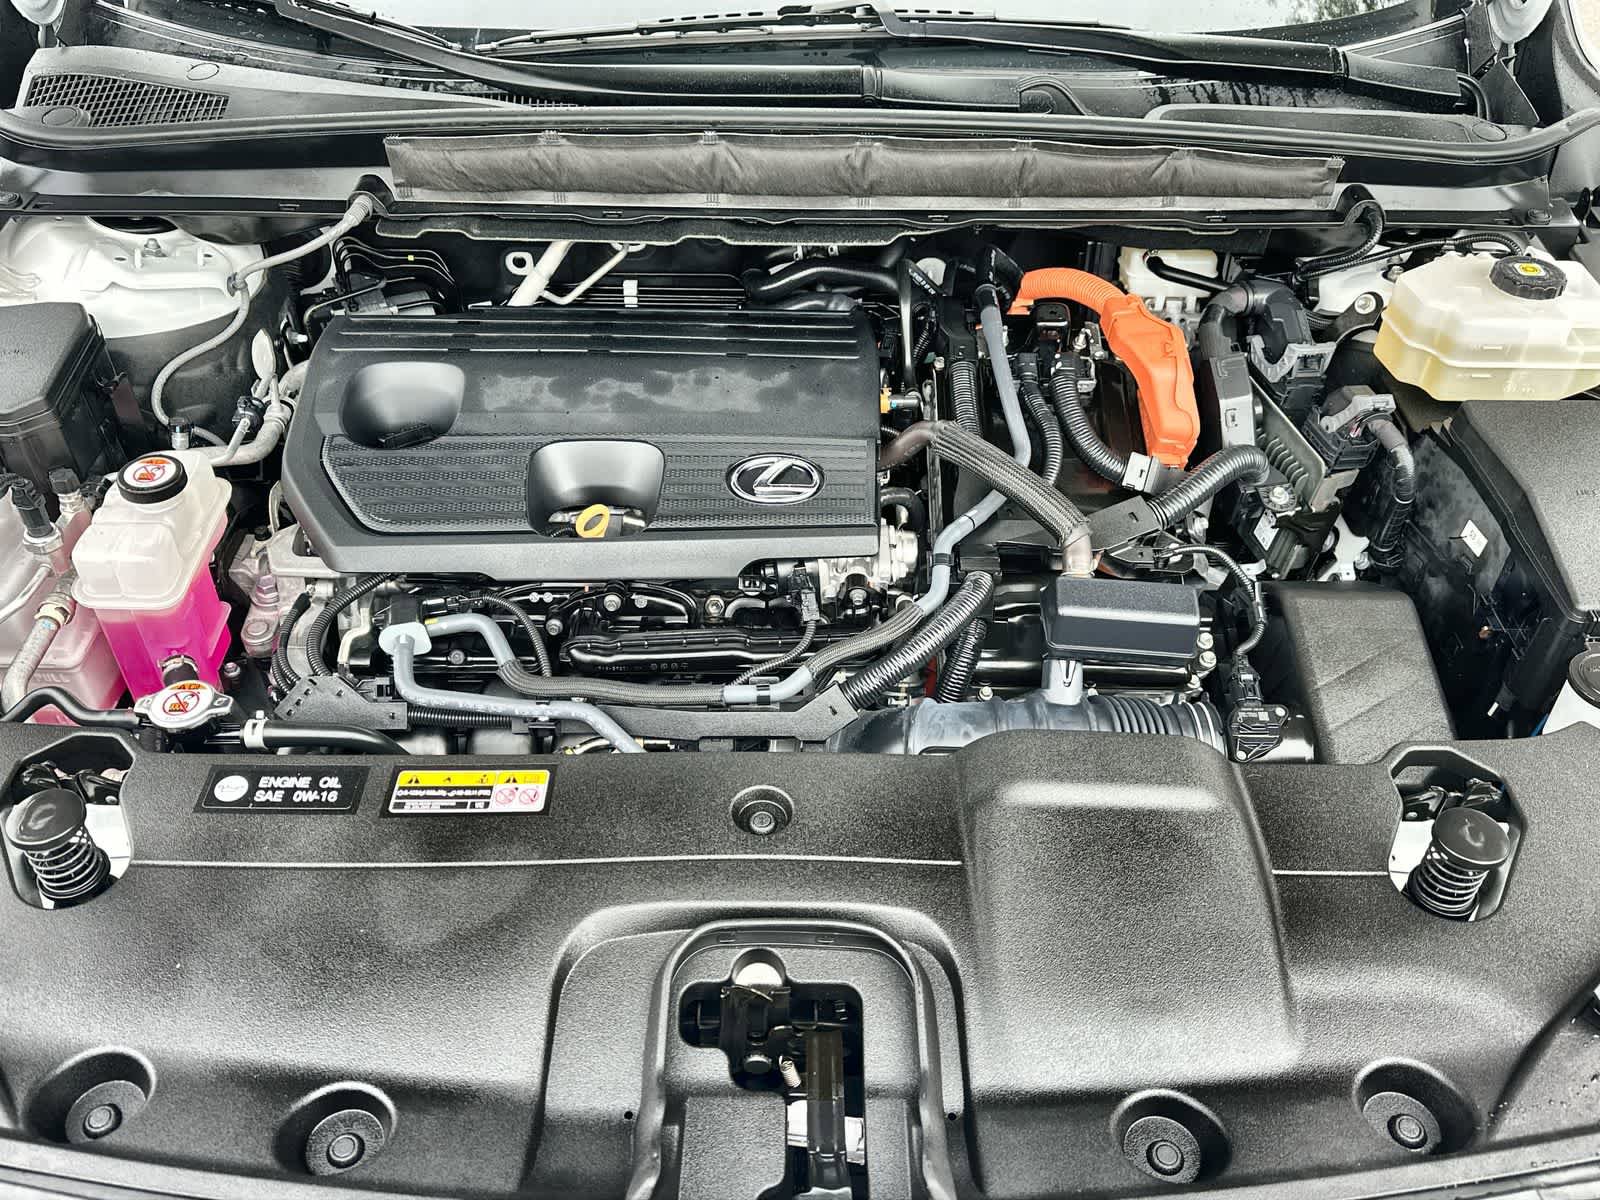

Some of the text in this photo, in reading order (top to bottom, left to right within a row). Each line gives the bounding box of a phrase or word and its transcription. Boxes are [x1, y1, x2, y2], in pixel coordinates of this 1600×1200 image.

[258, 776, 312, 788] ENGINE
[318, 776, 342, 788] OIL
[253, 790, 338, 802] SAE 0W-16
